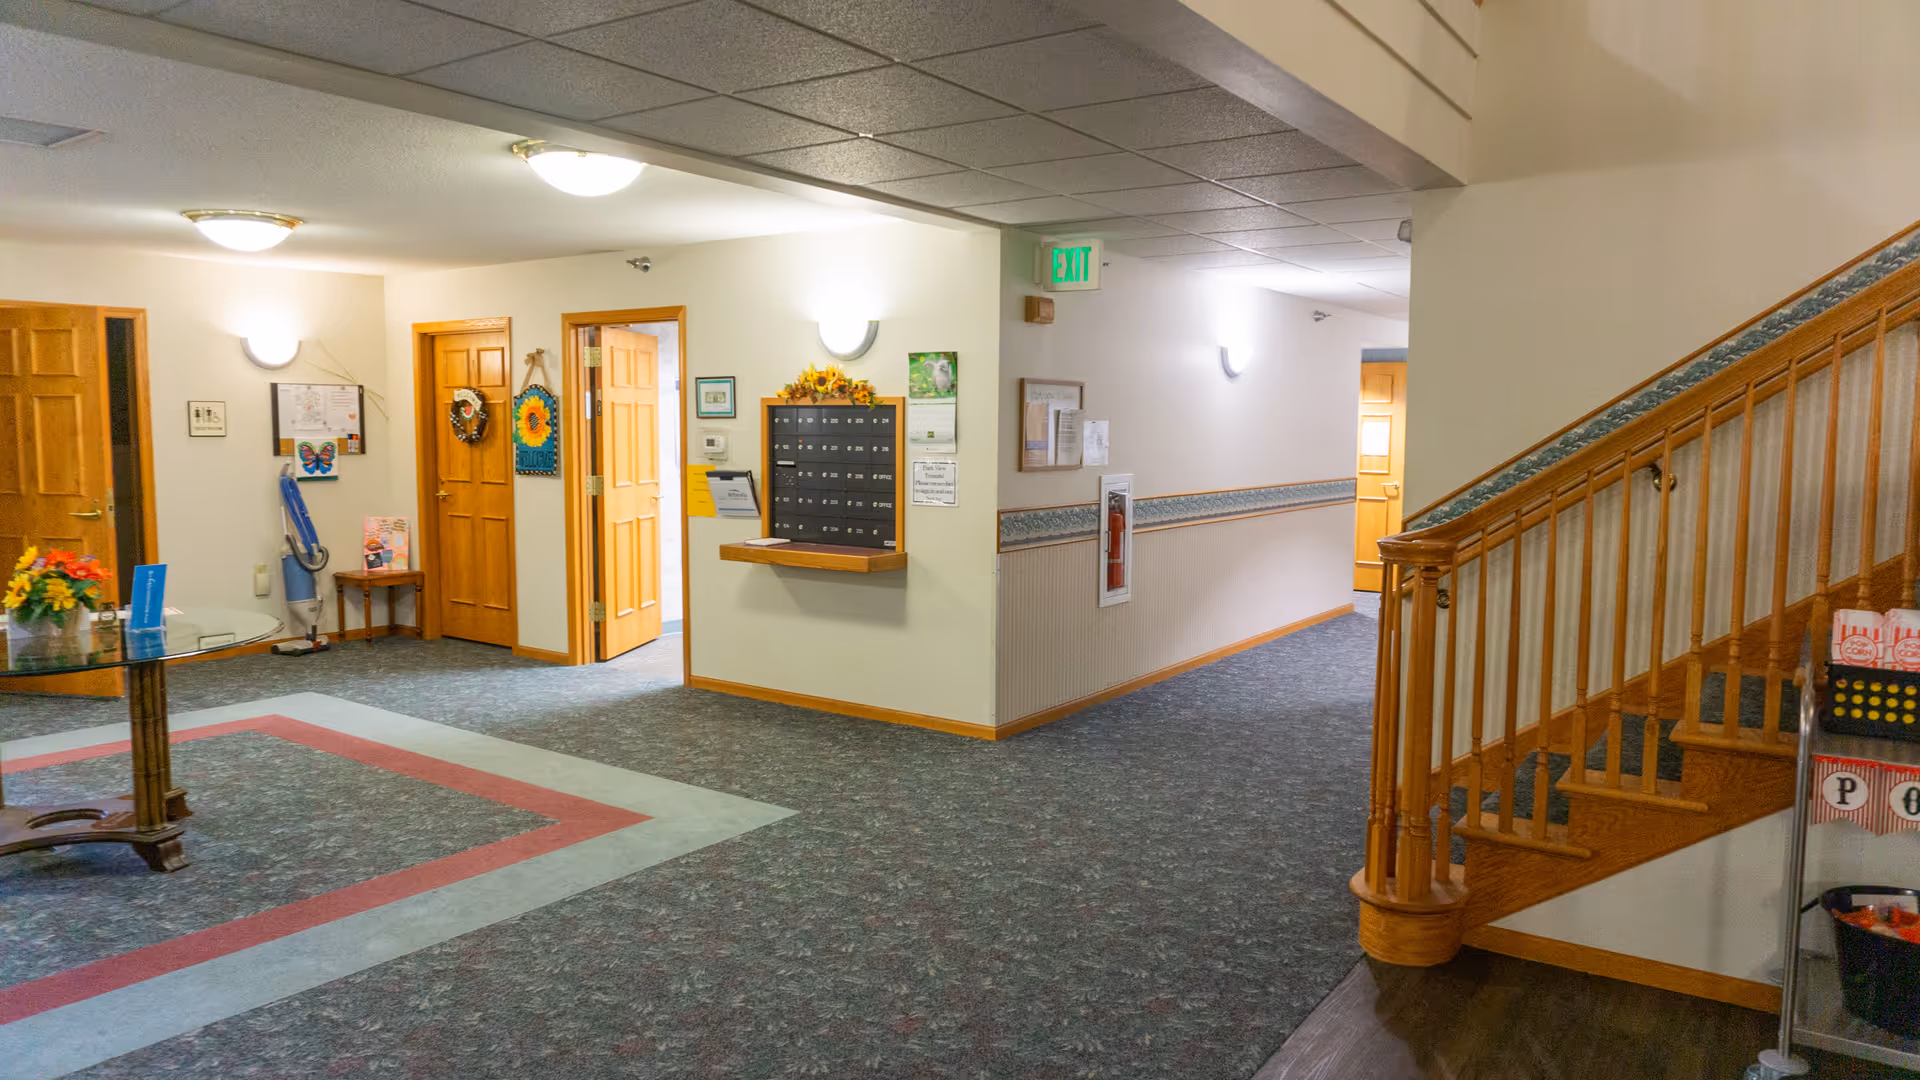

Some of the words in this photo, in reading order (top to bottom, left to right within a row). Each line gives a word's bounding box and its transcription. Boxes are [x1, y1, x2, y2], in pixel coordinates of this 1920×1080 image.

[1052, 246, 1092, 283] EXIT
[1845, 647, 1872, 656] CORN
[1850, 640, 1869, 648] POP
[1836, 777, 1857, 805] P
